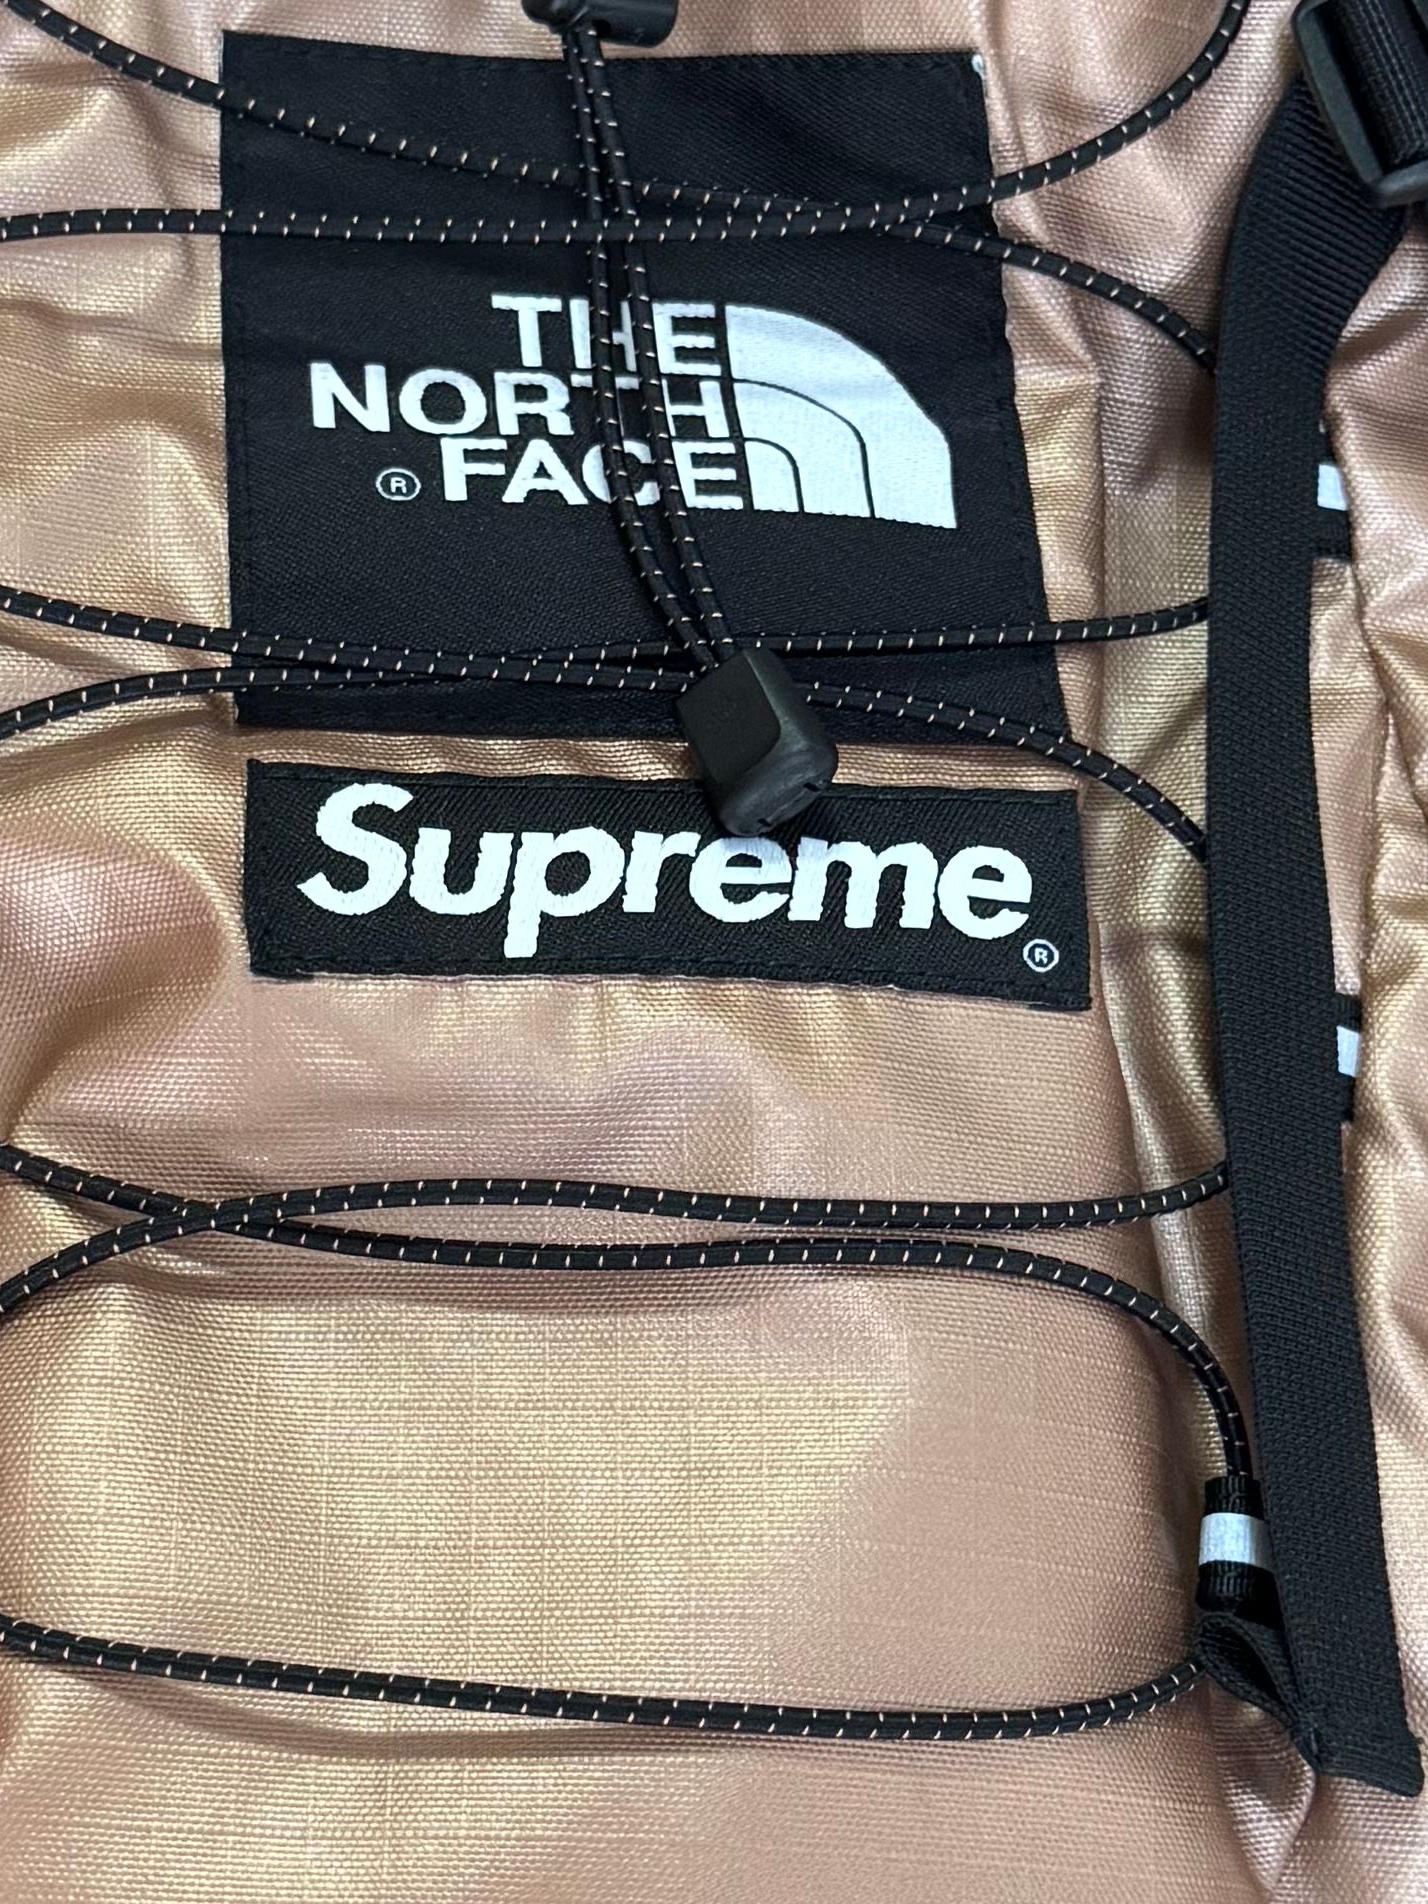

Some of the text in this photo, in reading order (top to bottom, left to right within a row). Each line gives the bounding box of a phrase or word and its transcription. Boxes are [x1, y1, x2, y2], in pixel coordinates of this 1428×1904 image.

[491, 293, 722, 377] THE
[439, 437, 744, 511] FACE
[296, 782, 1033, 959] Supreme
